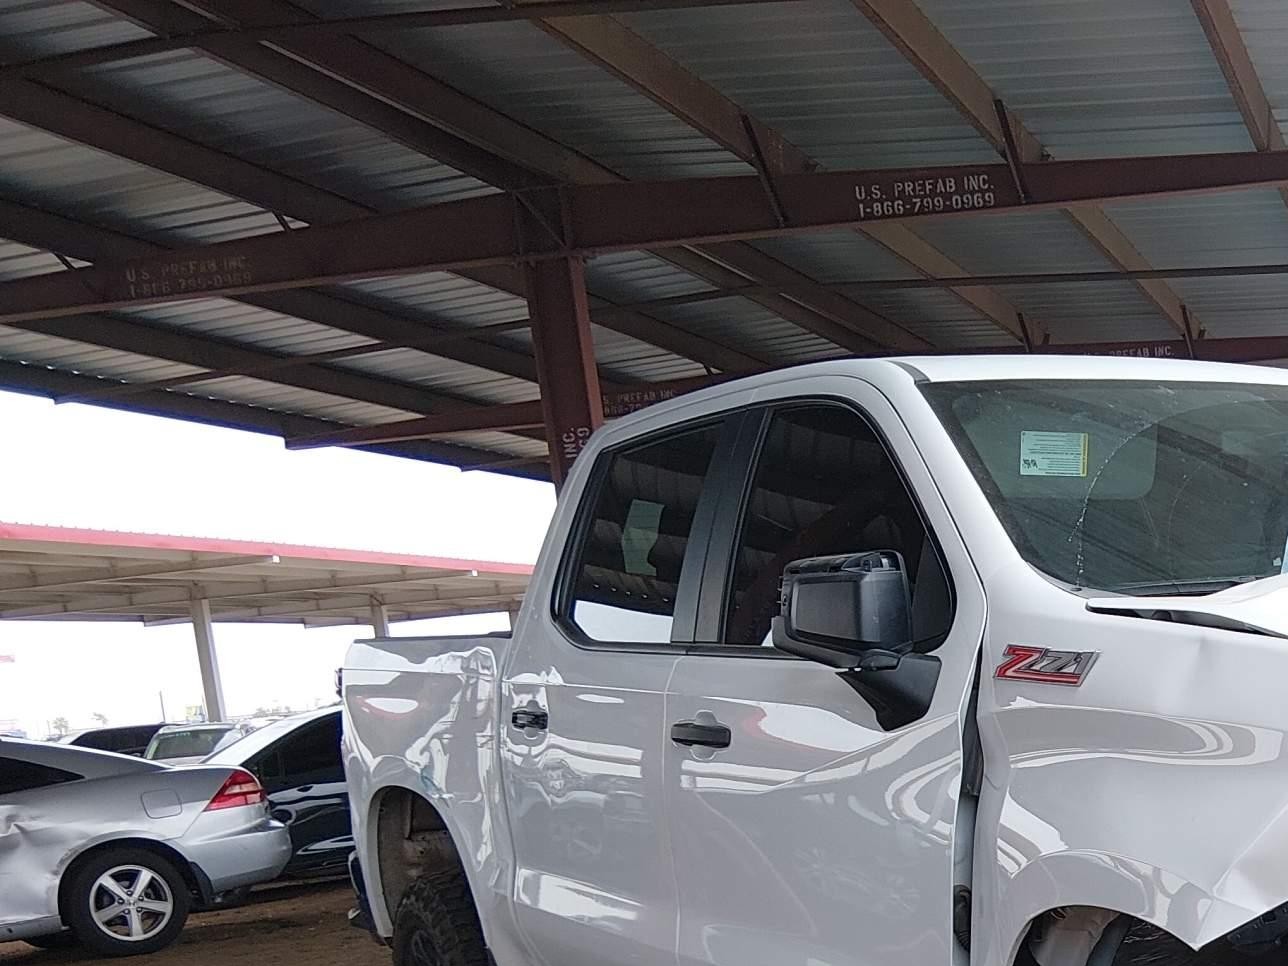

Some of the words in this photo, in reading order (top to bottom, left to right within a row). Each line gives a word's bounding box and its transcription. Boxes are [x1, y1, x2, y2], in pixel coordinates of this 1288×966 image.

[855, 185, 887, 201] U.S.
[893, 177, 957, 198] PREFAB
[963, 174, 995, 192] INC.
[858, 192, 996, 219] 1-866-799-0969
[562, 427, 578, 459] INC.
[992, 643, 1100, 688] Z71
